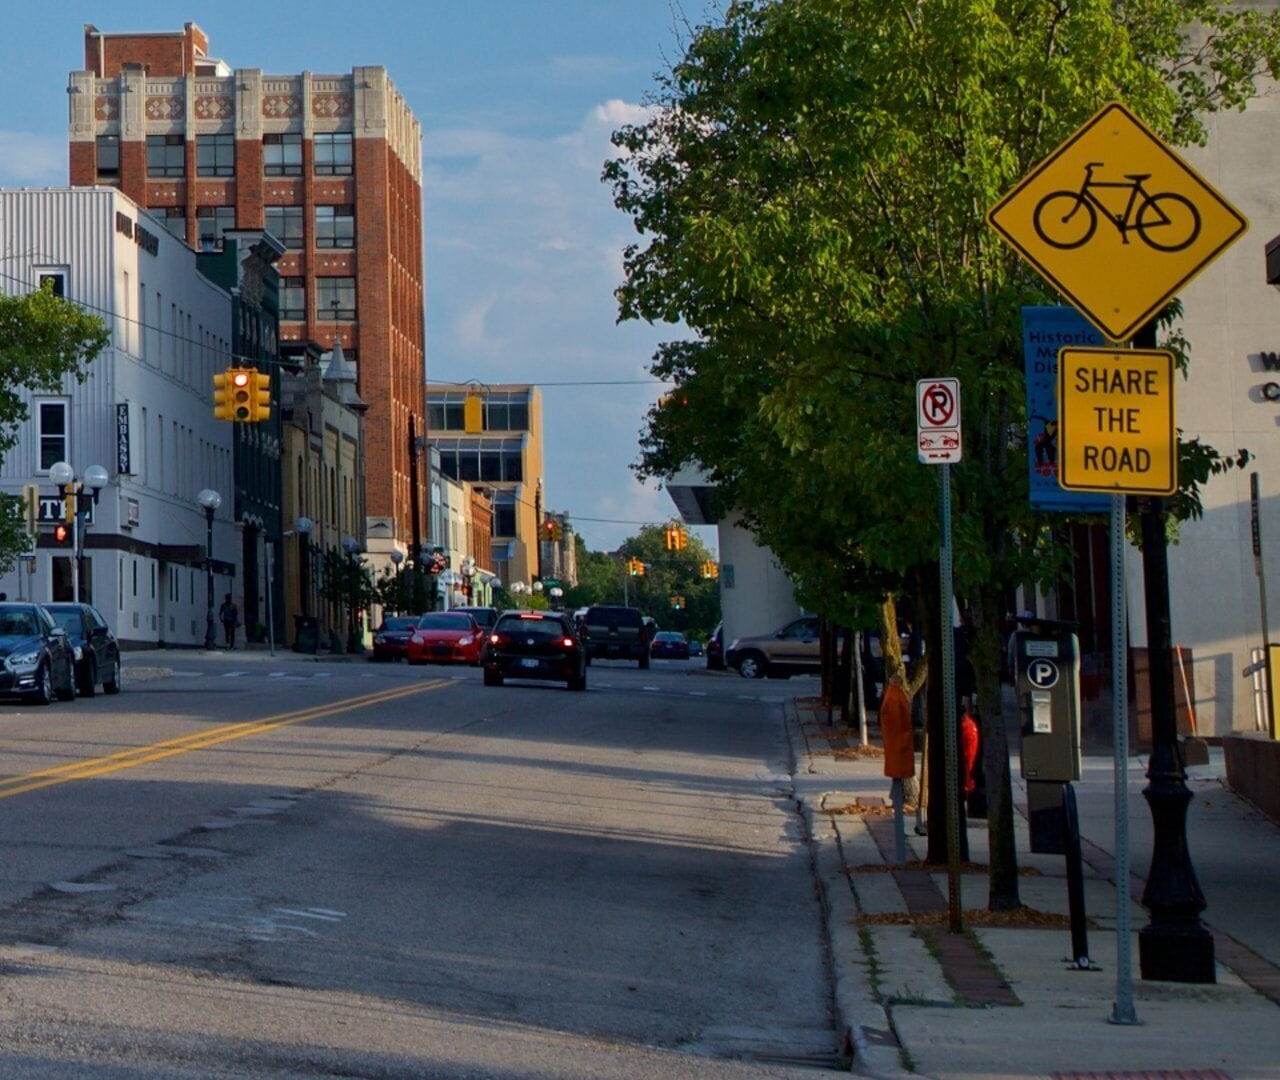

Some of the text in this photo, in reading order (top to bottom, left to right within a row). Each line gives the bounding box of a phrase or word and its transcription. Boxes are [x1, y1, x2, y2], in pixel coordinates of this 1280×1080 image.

[1029, 330, 1097, 344] Historic
[1075, 368, 1159, 395] SHARE
[1093, 407, 1141, 434] THE
[118, 405, 129, 473] EMBASSY
[1083, 445, 1151, 473] ROAD
[1036, 663, 1052, 683] P
